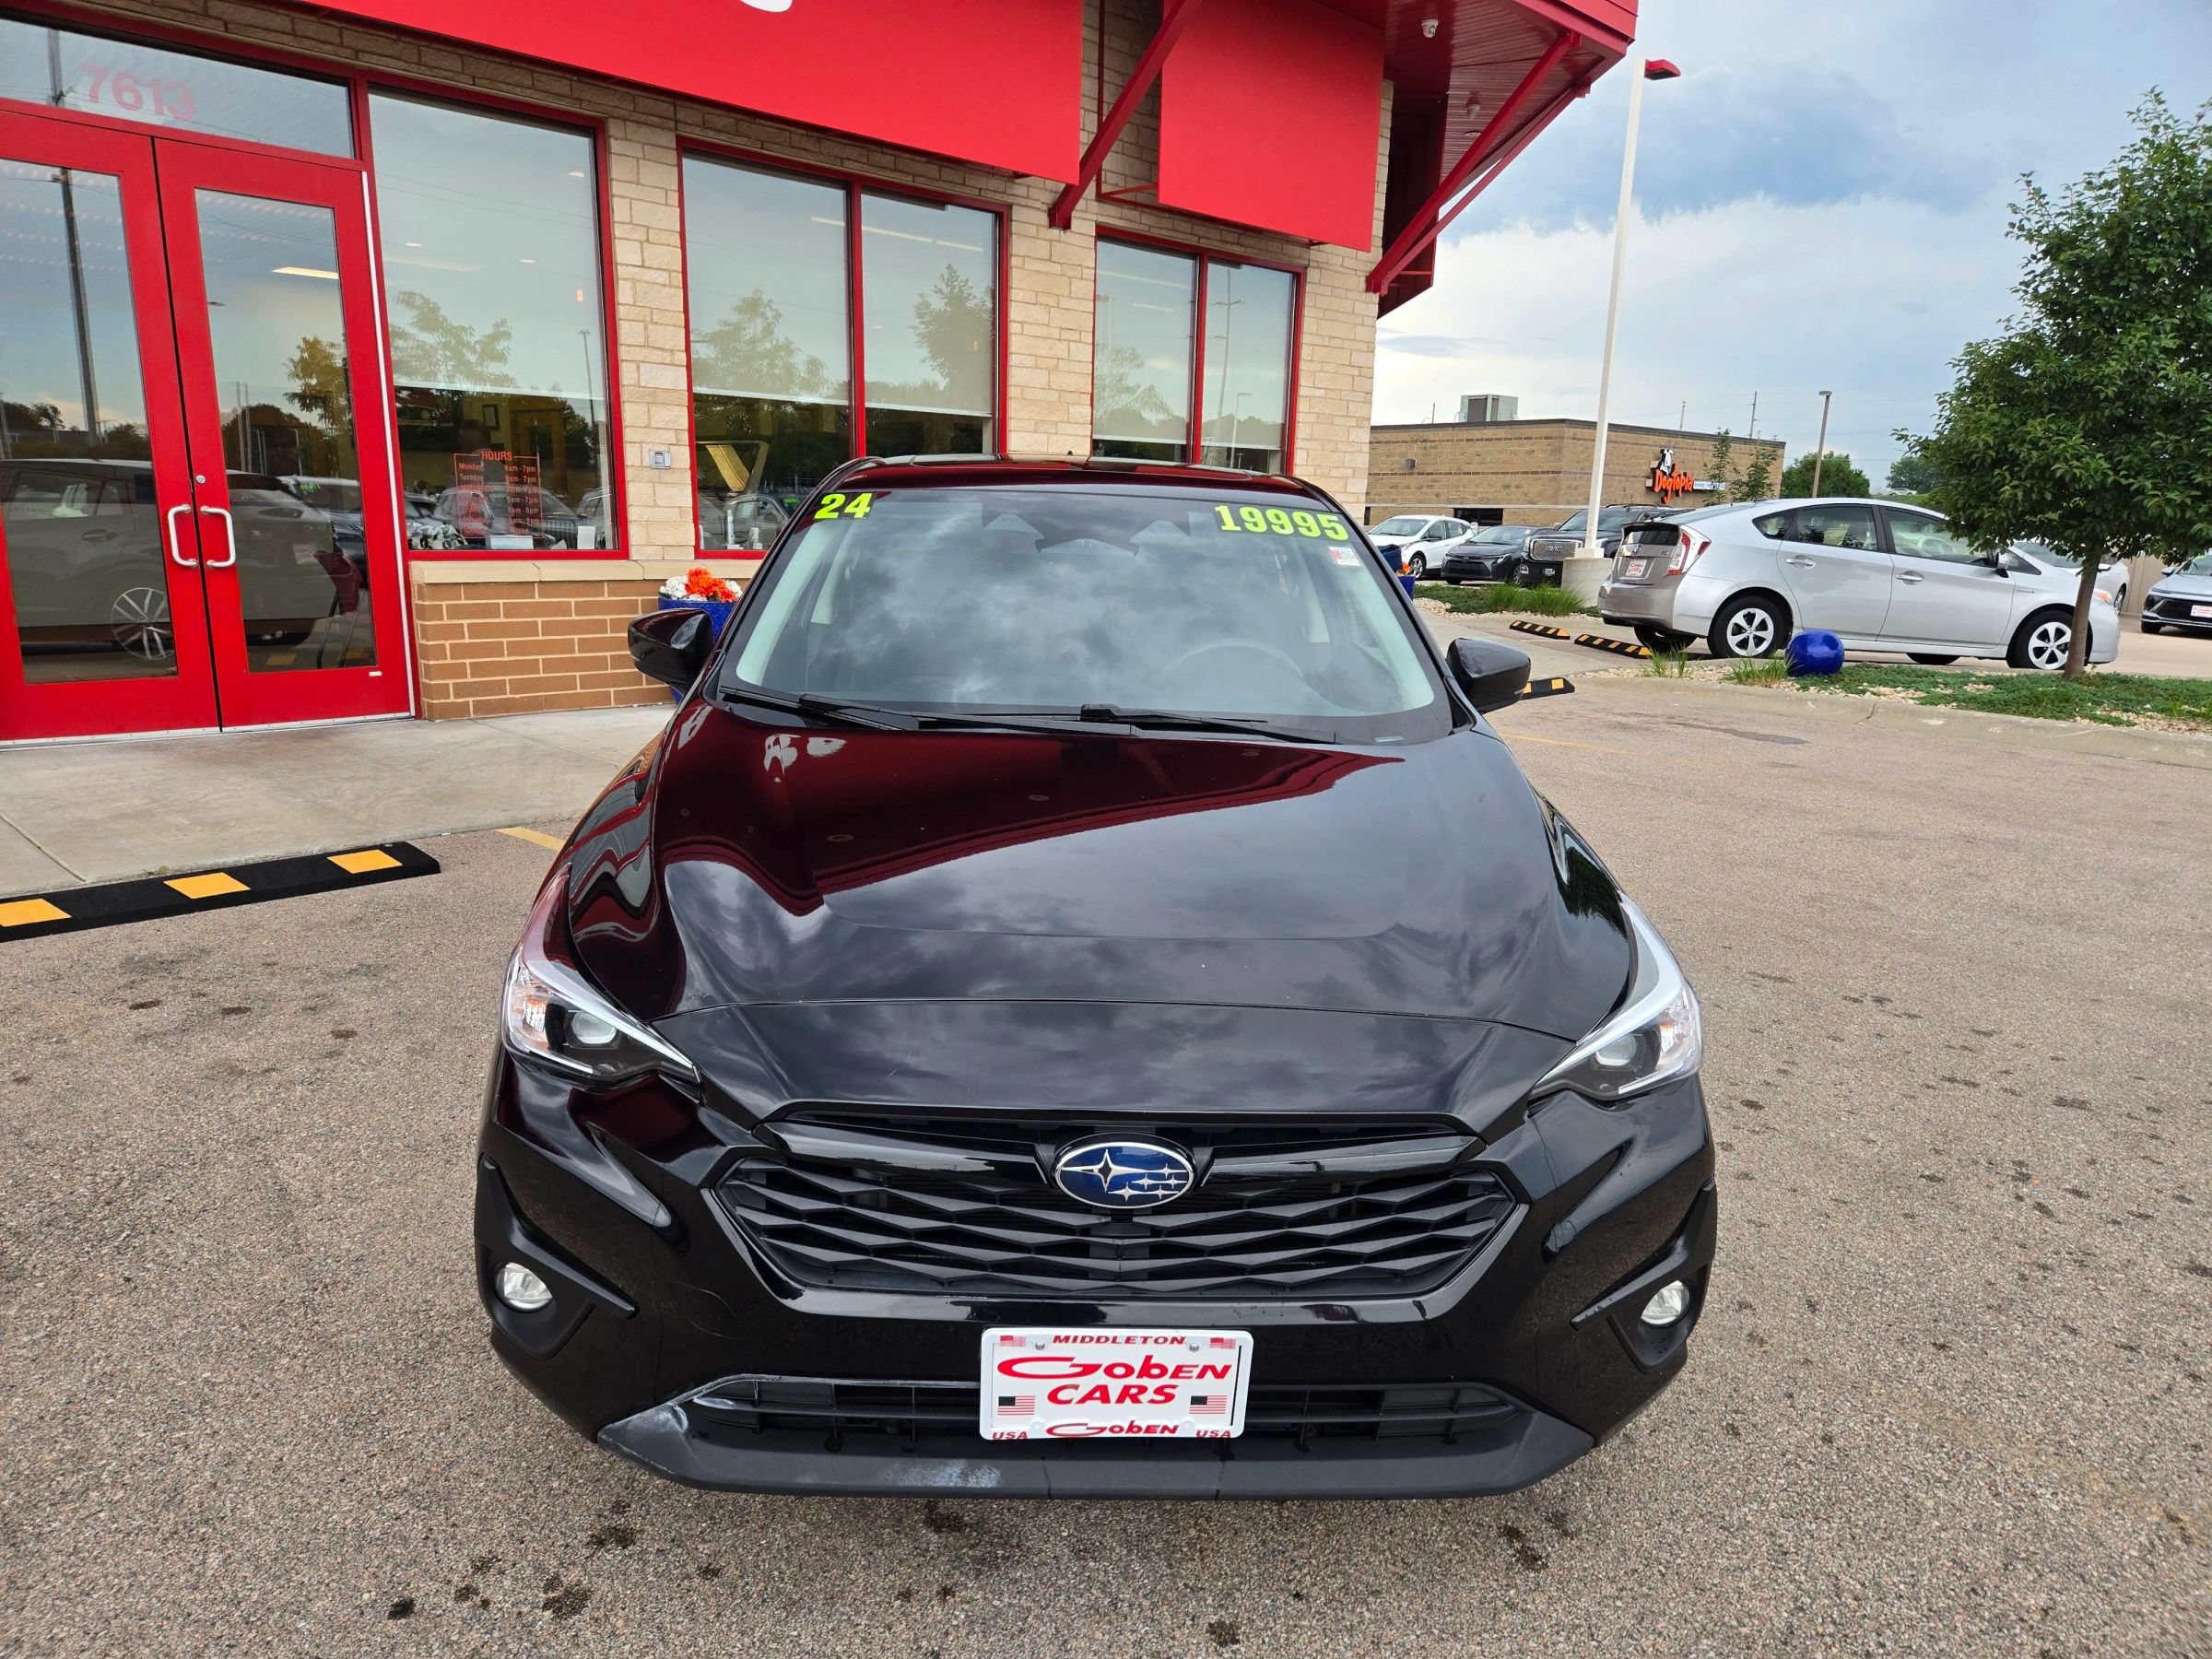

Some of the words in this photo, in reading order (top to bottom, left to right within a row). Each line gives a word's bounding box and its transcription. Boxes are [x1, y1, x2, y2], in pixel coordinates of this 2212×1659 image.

[80, 63, 196, 120] 7613
[481, 451, 512, 461] HOURS
[815, 492, 873, 519] 24
[1214, 505, 1349, 541] 19995
[1053, 1335, 1186, 1345] MIDDLETON
[1047, 1383, 1180, 1405] CARS
[992, 1431, 1028, 1440] USA
[1195, 1430, 1230, 1439] USA
